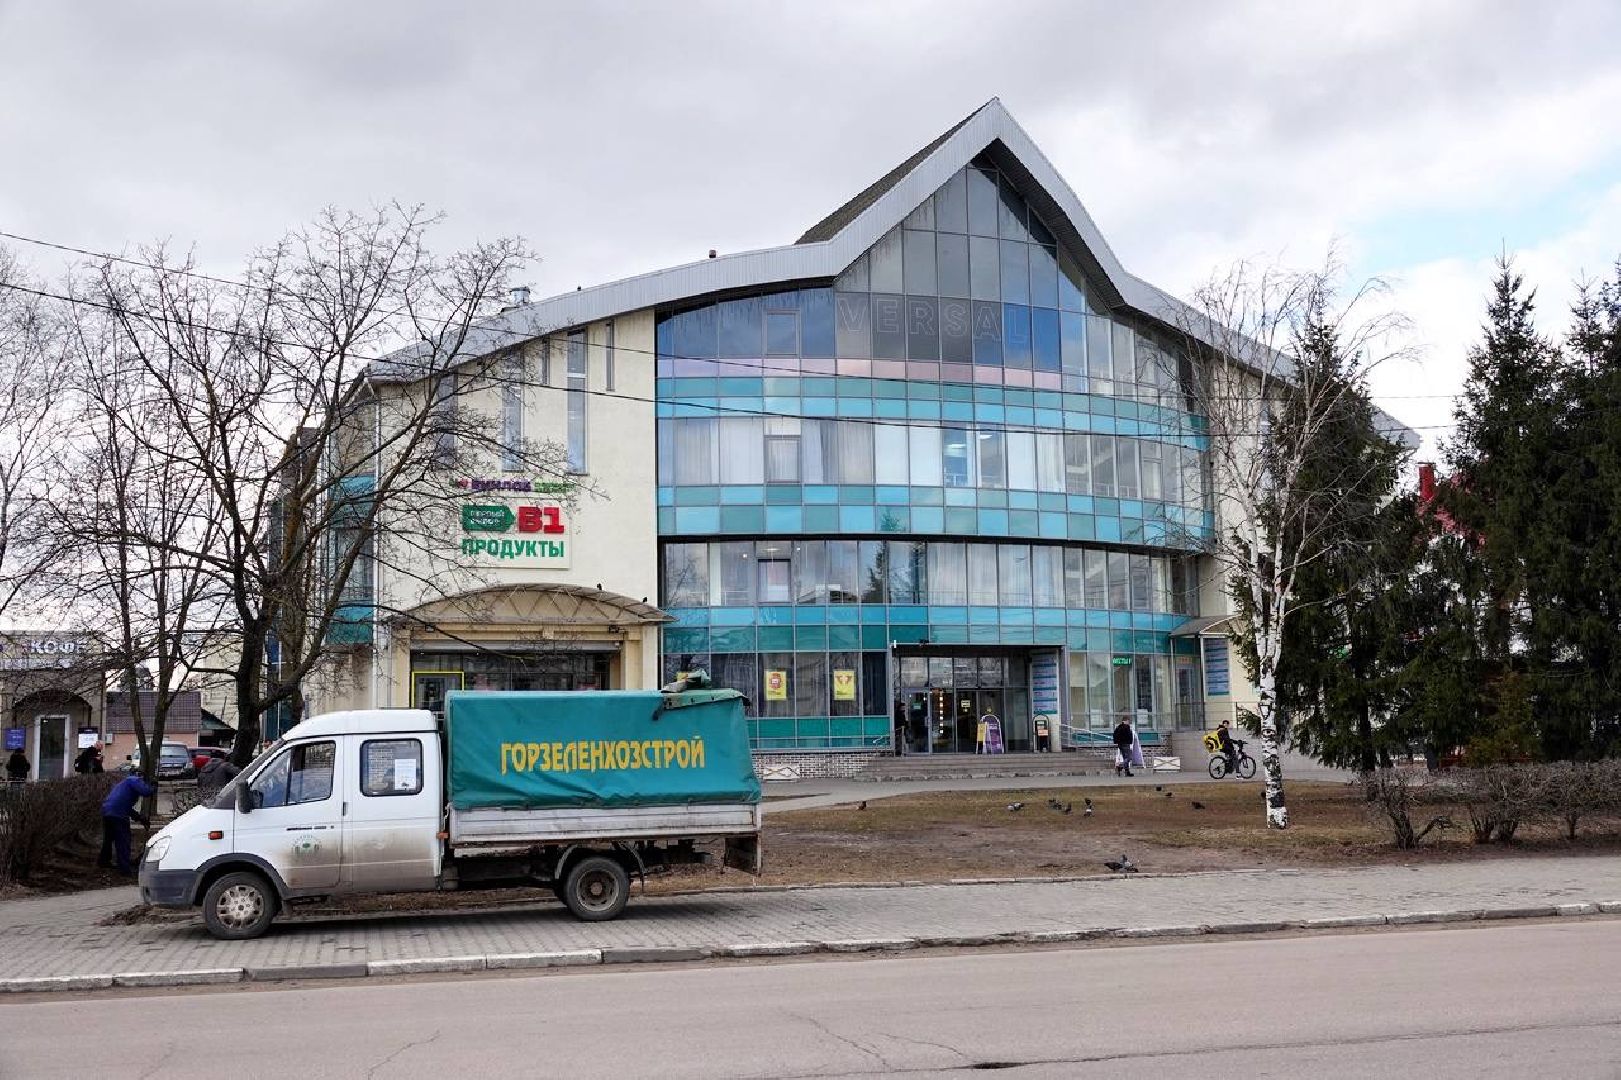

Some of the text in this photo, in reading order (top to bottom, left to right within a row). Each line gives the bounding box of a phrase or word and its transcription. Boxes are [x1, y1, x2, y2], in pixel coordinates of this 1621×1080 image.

[837, 297, 1028, 344] VERSAL
[462, 539, 565, 559] ПРОДУКТЫ
[500, 735, 706, 775] ГОРЗЕЛЕНХОЗСТРОЙ
